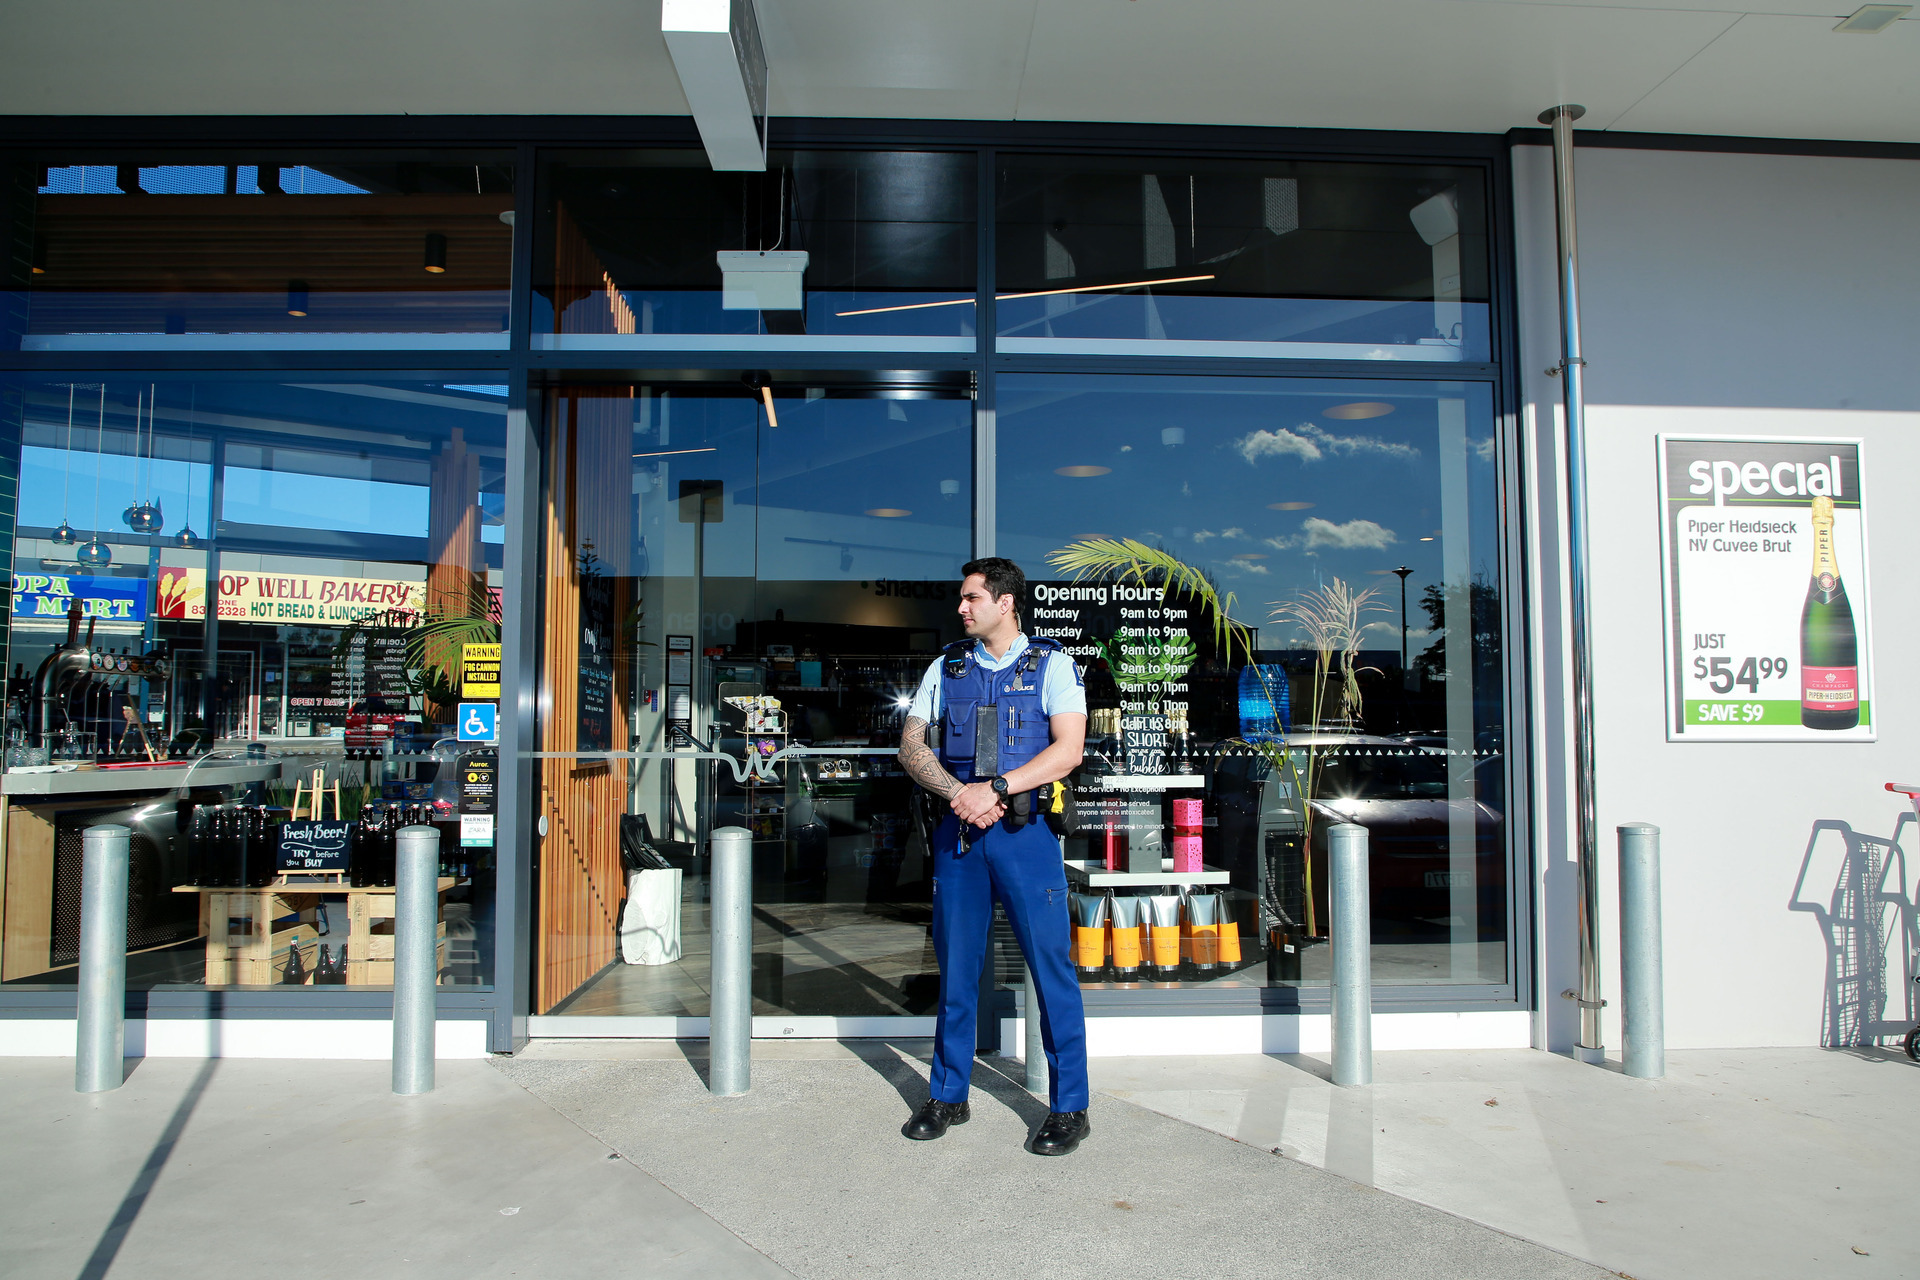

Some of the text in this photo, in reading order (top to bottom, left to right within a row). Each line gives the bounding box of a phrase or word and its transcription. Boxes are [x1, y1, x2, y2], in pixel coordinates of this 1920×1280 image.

[1688, 455, 1843, 506] special
[1688, 520, 1797, 536] Piper Heidsieck
[1688, 538, 1791, 553] NV Cuvee Brut
[1819, 529, 1829, 563] PIPER
[257, 577, 314, 599] WELL
[320, 581, 410, 606] BAKERY
[1034, 584, 1165, 606] Opening Hours
[34, 596, 134, 618] MRT
[251, 602, 273, 617] HOT
[278, 603, 314, 619] BREAD
[318, 605, 325, 619] &
[1034, 608, 1188, 622] Monday 9am to 9pm
[1034, 626, 1188, 641] Tuesday 9am to 9pm
[1693, 633, 1726, 650] JUST
[465, 647, 500, 658] WARNING
[1061, 644, 1188, 659] nesday 9am to 9pm
[464, 662, 500, 672] FOG CANNON
[1120, 663, 1188, 678] 9am to 9pm
[467, 672, 497, 682] INSTALLED
[1120, 682, 1188, 696] 9am to 11pm
[291, 698, 314, 706] OPEN
[1120, 700, 1188, 714] 9am to 11pm
[1698, 703, 1764, 722] SAVE $9
[1164, 719, 1189, 733] 8pm
[1127, 731, 1168, 747] SHORT
[1129, 755, 1171, 775] bubbles
[314, 823, 349, 840] Beer!
[292, 849, 339, 858] TRY before
[286, 858, 323, 868] you BUY
